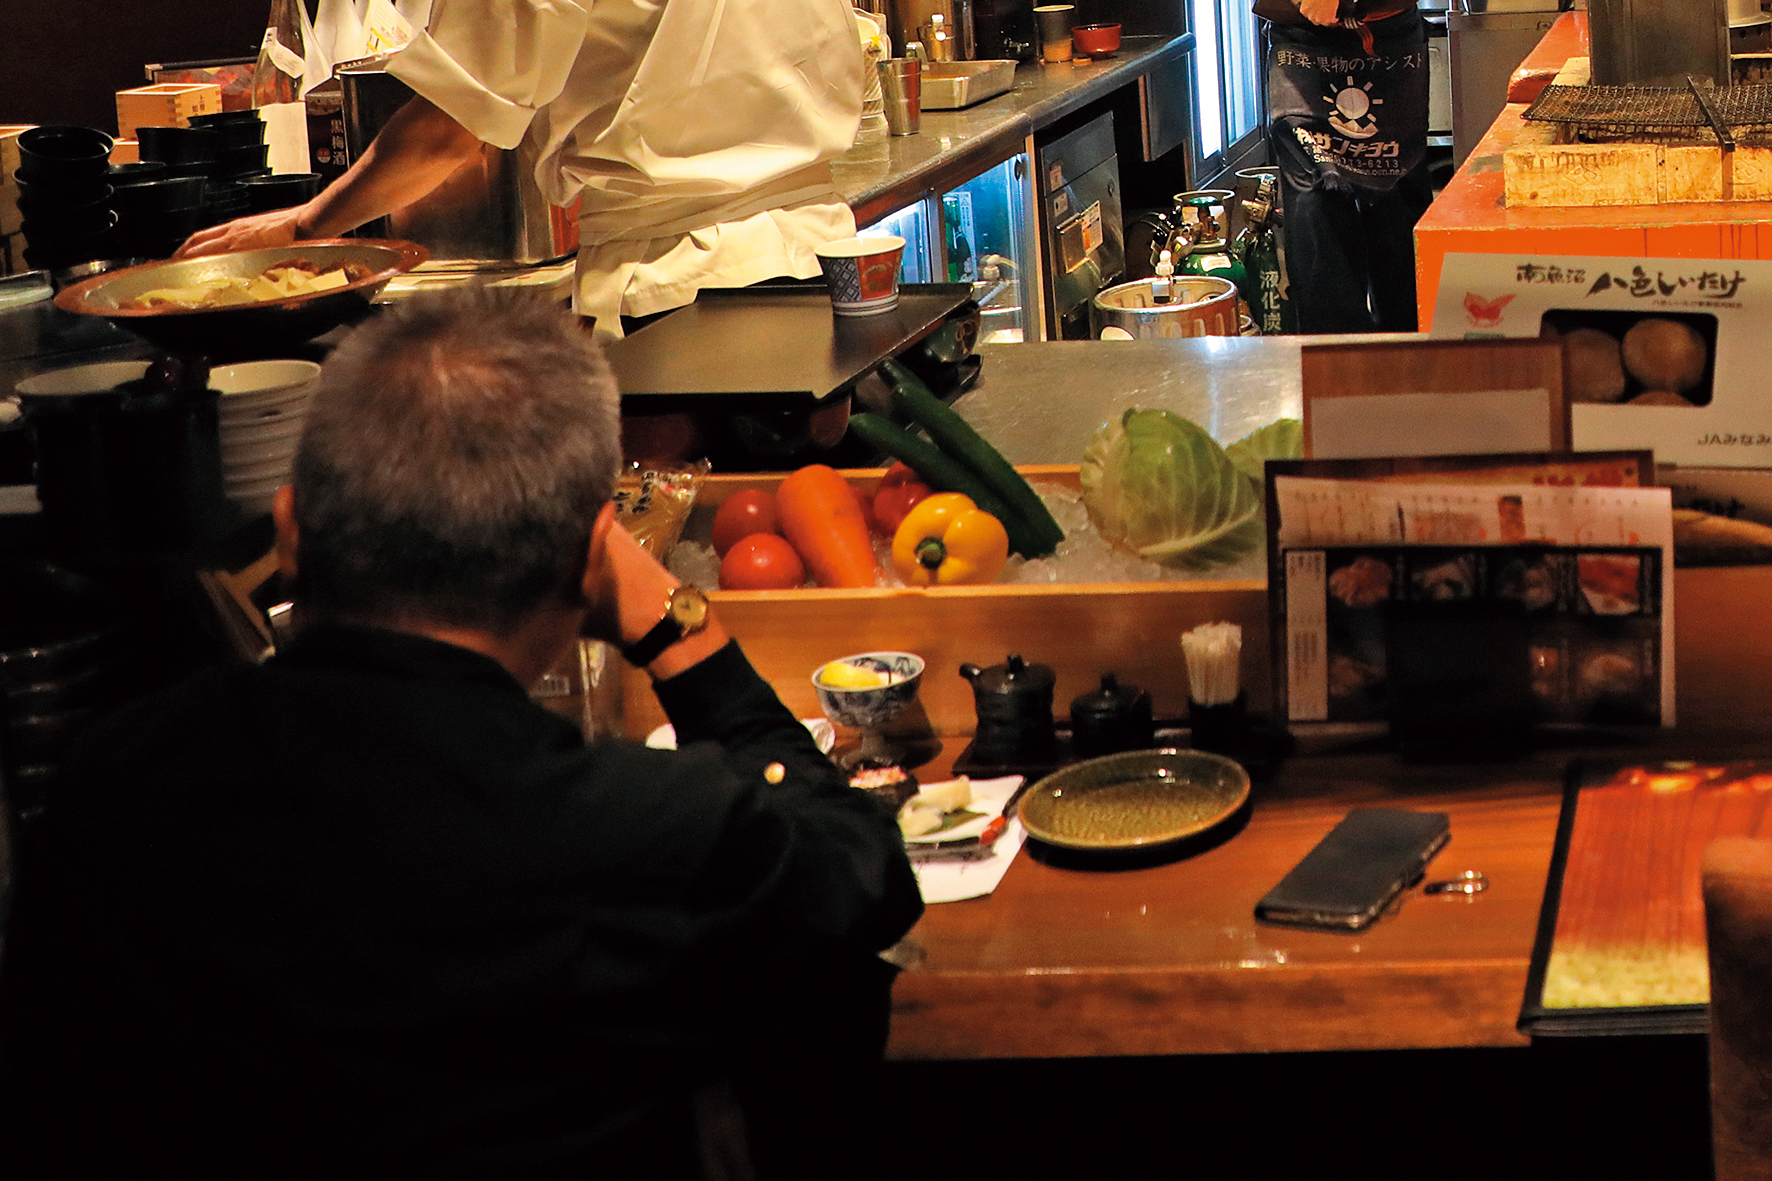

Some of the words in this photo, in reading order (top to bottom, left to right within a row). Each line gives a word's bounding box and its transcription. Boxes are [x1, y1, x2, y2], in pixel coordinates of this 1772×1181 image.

[1584, 265, 1747, 299] 八色しいたけ
